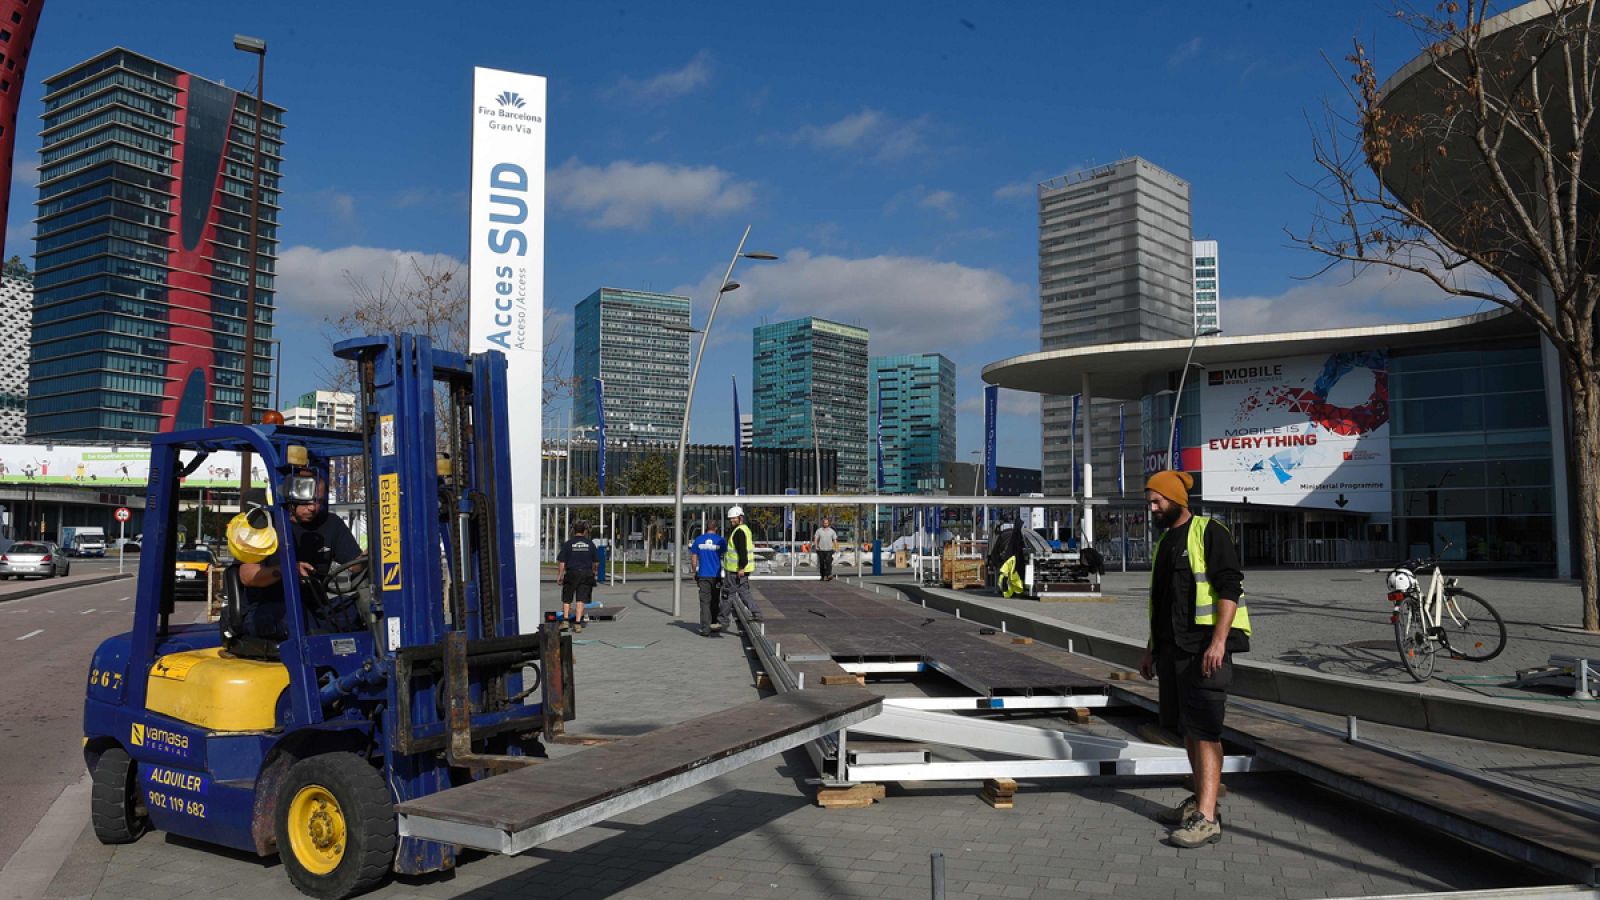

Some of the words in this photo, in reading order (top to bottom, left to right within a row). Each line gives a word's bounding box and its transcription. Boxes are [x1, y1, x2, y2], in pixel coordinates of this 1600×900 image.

[478, 106, 496, 117] Fira
[498, 108, 542, 123] Barcelona
[489, 119, 513, 132] Gran
[515, 123, 532, 135] Via
[487, 162, 529, 257] SUD
[486, 266, 513, 350] Acces
[1224, 364, 1283, 380] MOBILE
[1224, 426, 1280, 437] MOBILE
[1286, 424, 1300, 433] IS
[1209, 434, 1317, 450] EVERYTHING
[1340, 482, 1383, 490] Programme
[381, 479, 393, 558] vamasa
[90, 669, 123, 689] 867
[146, 726, 189, 748] vamasa
[150, 767, 202, 792] ALQUILER
[149, 790, 167, 808] 902
[169, 796, 184, 812] 119
[187, 801, 205, 818] 682
